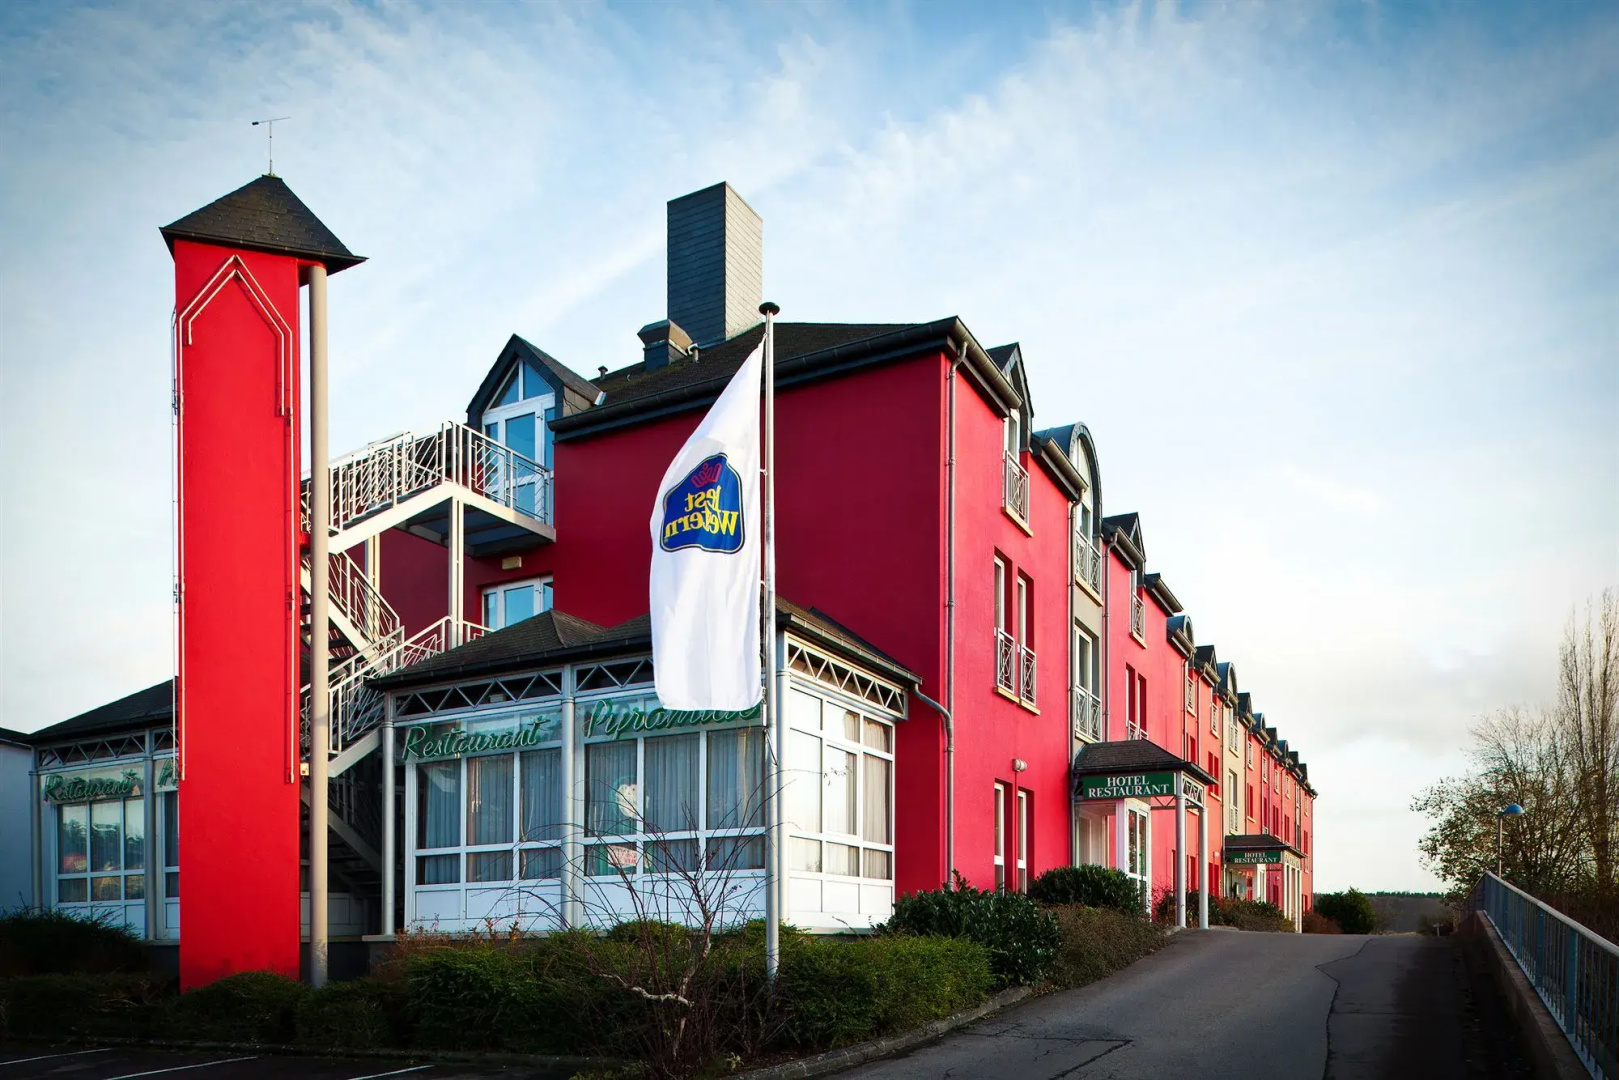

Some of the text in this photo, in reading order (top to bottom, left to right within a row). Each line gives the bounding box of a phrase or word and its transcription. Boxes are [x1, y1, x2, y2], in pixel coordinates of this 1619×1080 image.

[401, 714, 551, 761] Restaurant
[44, 769, 137, 802] Restaurant
[1088, 783, 1170, 798] RESTAURANT
[1107, 775, 1149, 787] HOTEL
